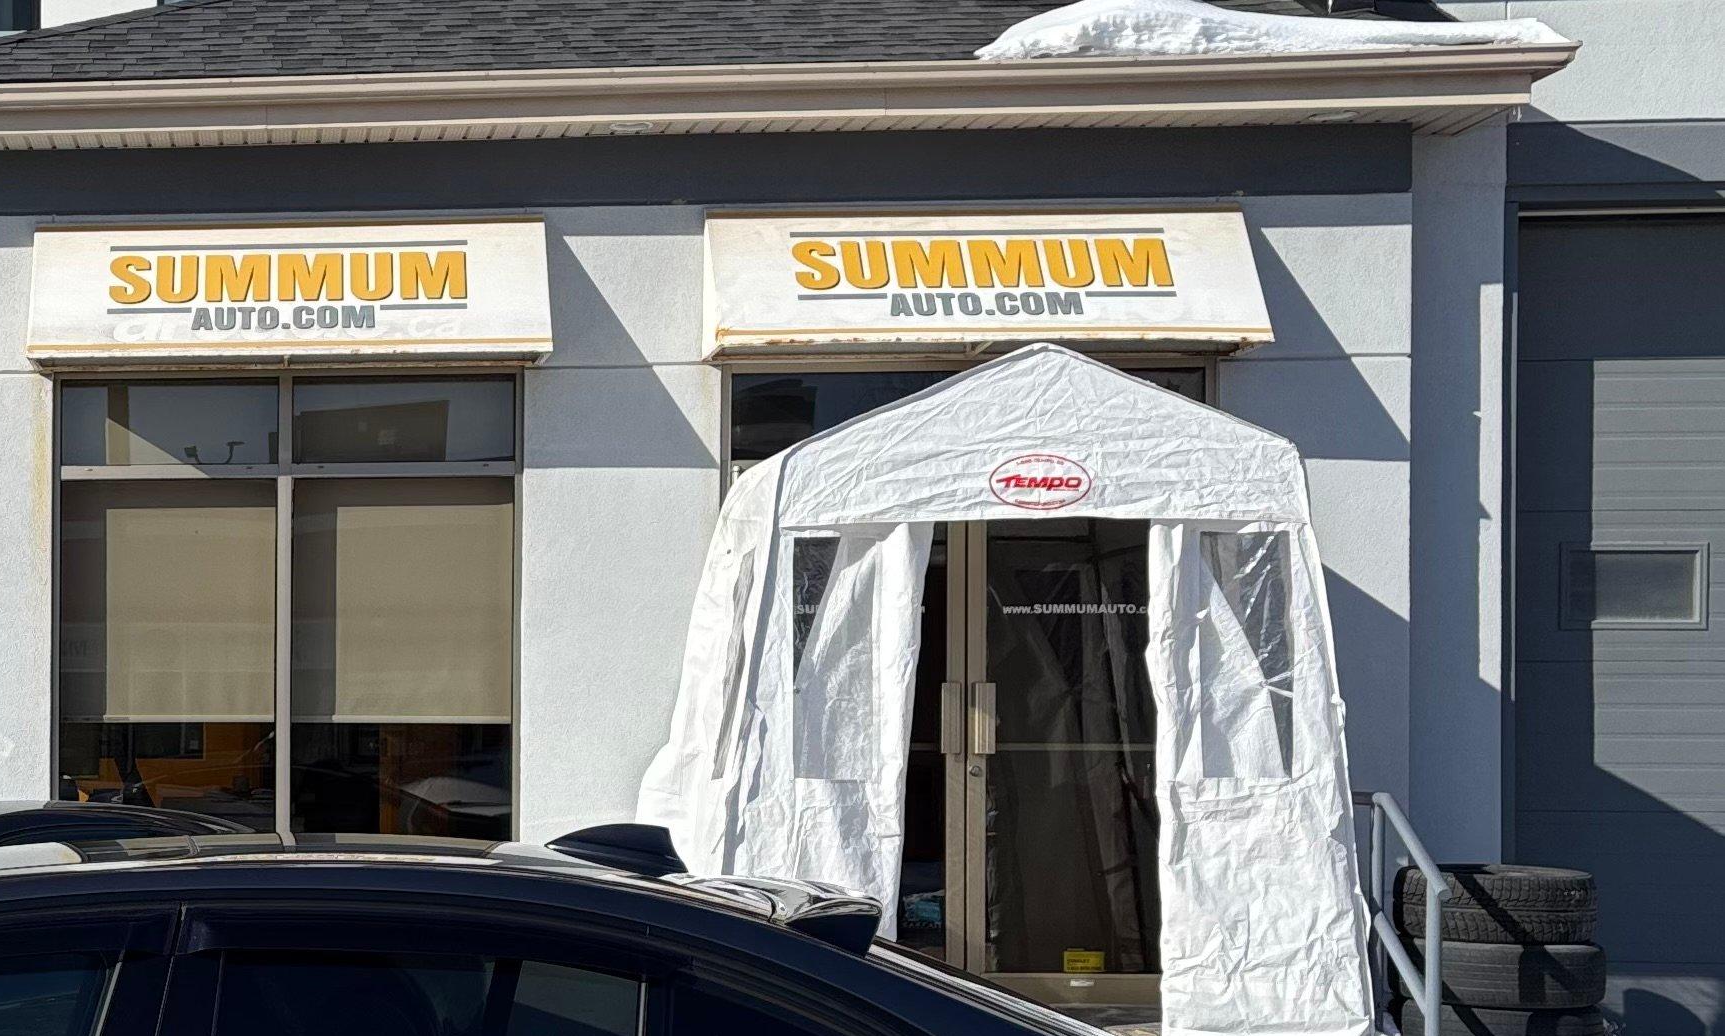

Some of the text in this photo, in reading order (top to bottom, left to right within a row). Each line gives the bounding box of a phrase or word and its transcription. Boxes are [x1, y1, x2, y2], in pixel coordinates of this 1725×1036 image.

[108, 250, 467, 305] SUMMUM
[791, 238, 1175, 291] SUMMUM
[191, 304, 376, 331] AUTO.COM
[890, 290, 1084, 318] AUTO.COM
[1002, 603, 1147, 615] www.SUMMUMAUTO.c
